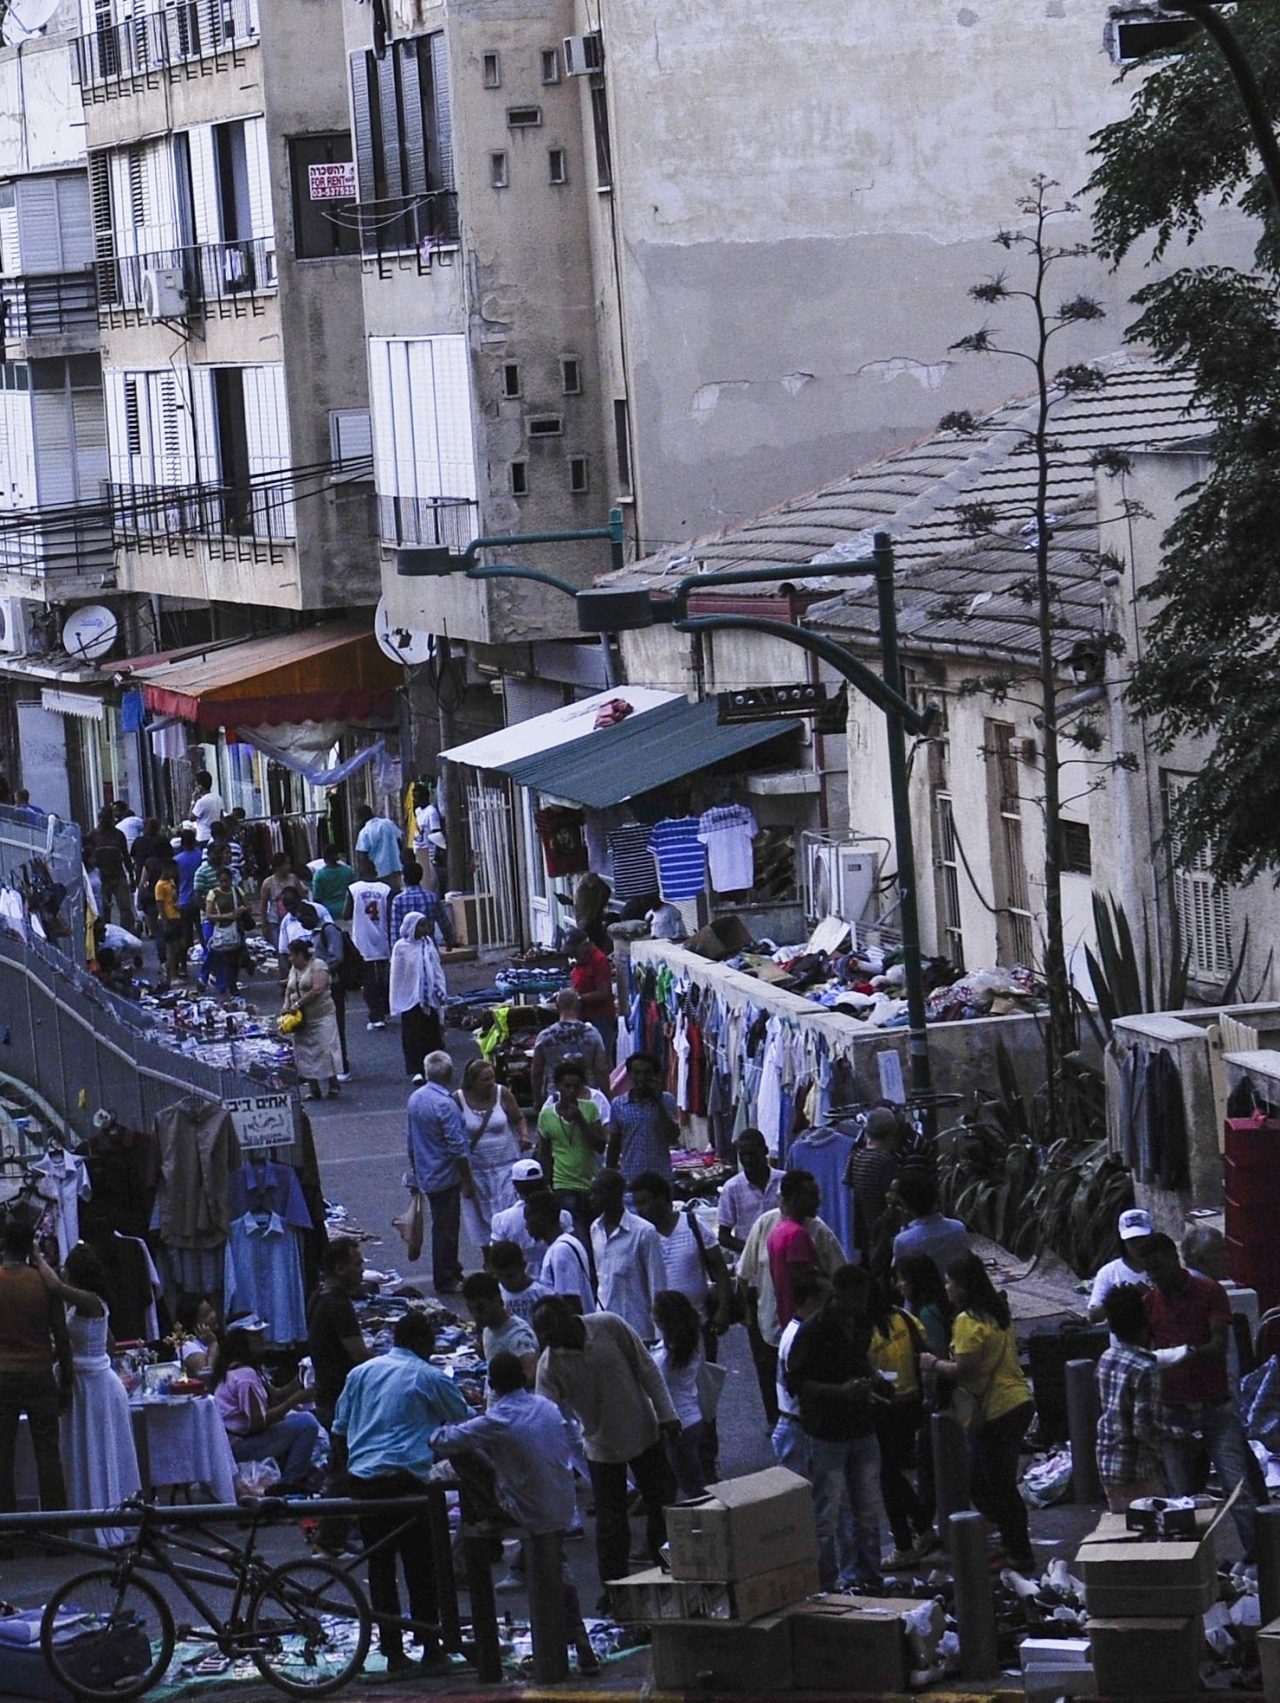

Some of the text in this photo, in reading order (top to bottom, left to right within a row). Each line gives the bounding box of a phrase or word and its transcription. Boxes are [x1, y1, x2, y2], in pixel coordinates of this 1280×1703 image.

[310, 165, 345, 176] להשכרה
[311, 176, 325, 187] FOR
[327, 175, 345, 186] RENT
[365, 901, 380, 921] 4
[256, 1095, 287, 1109] אחים
